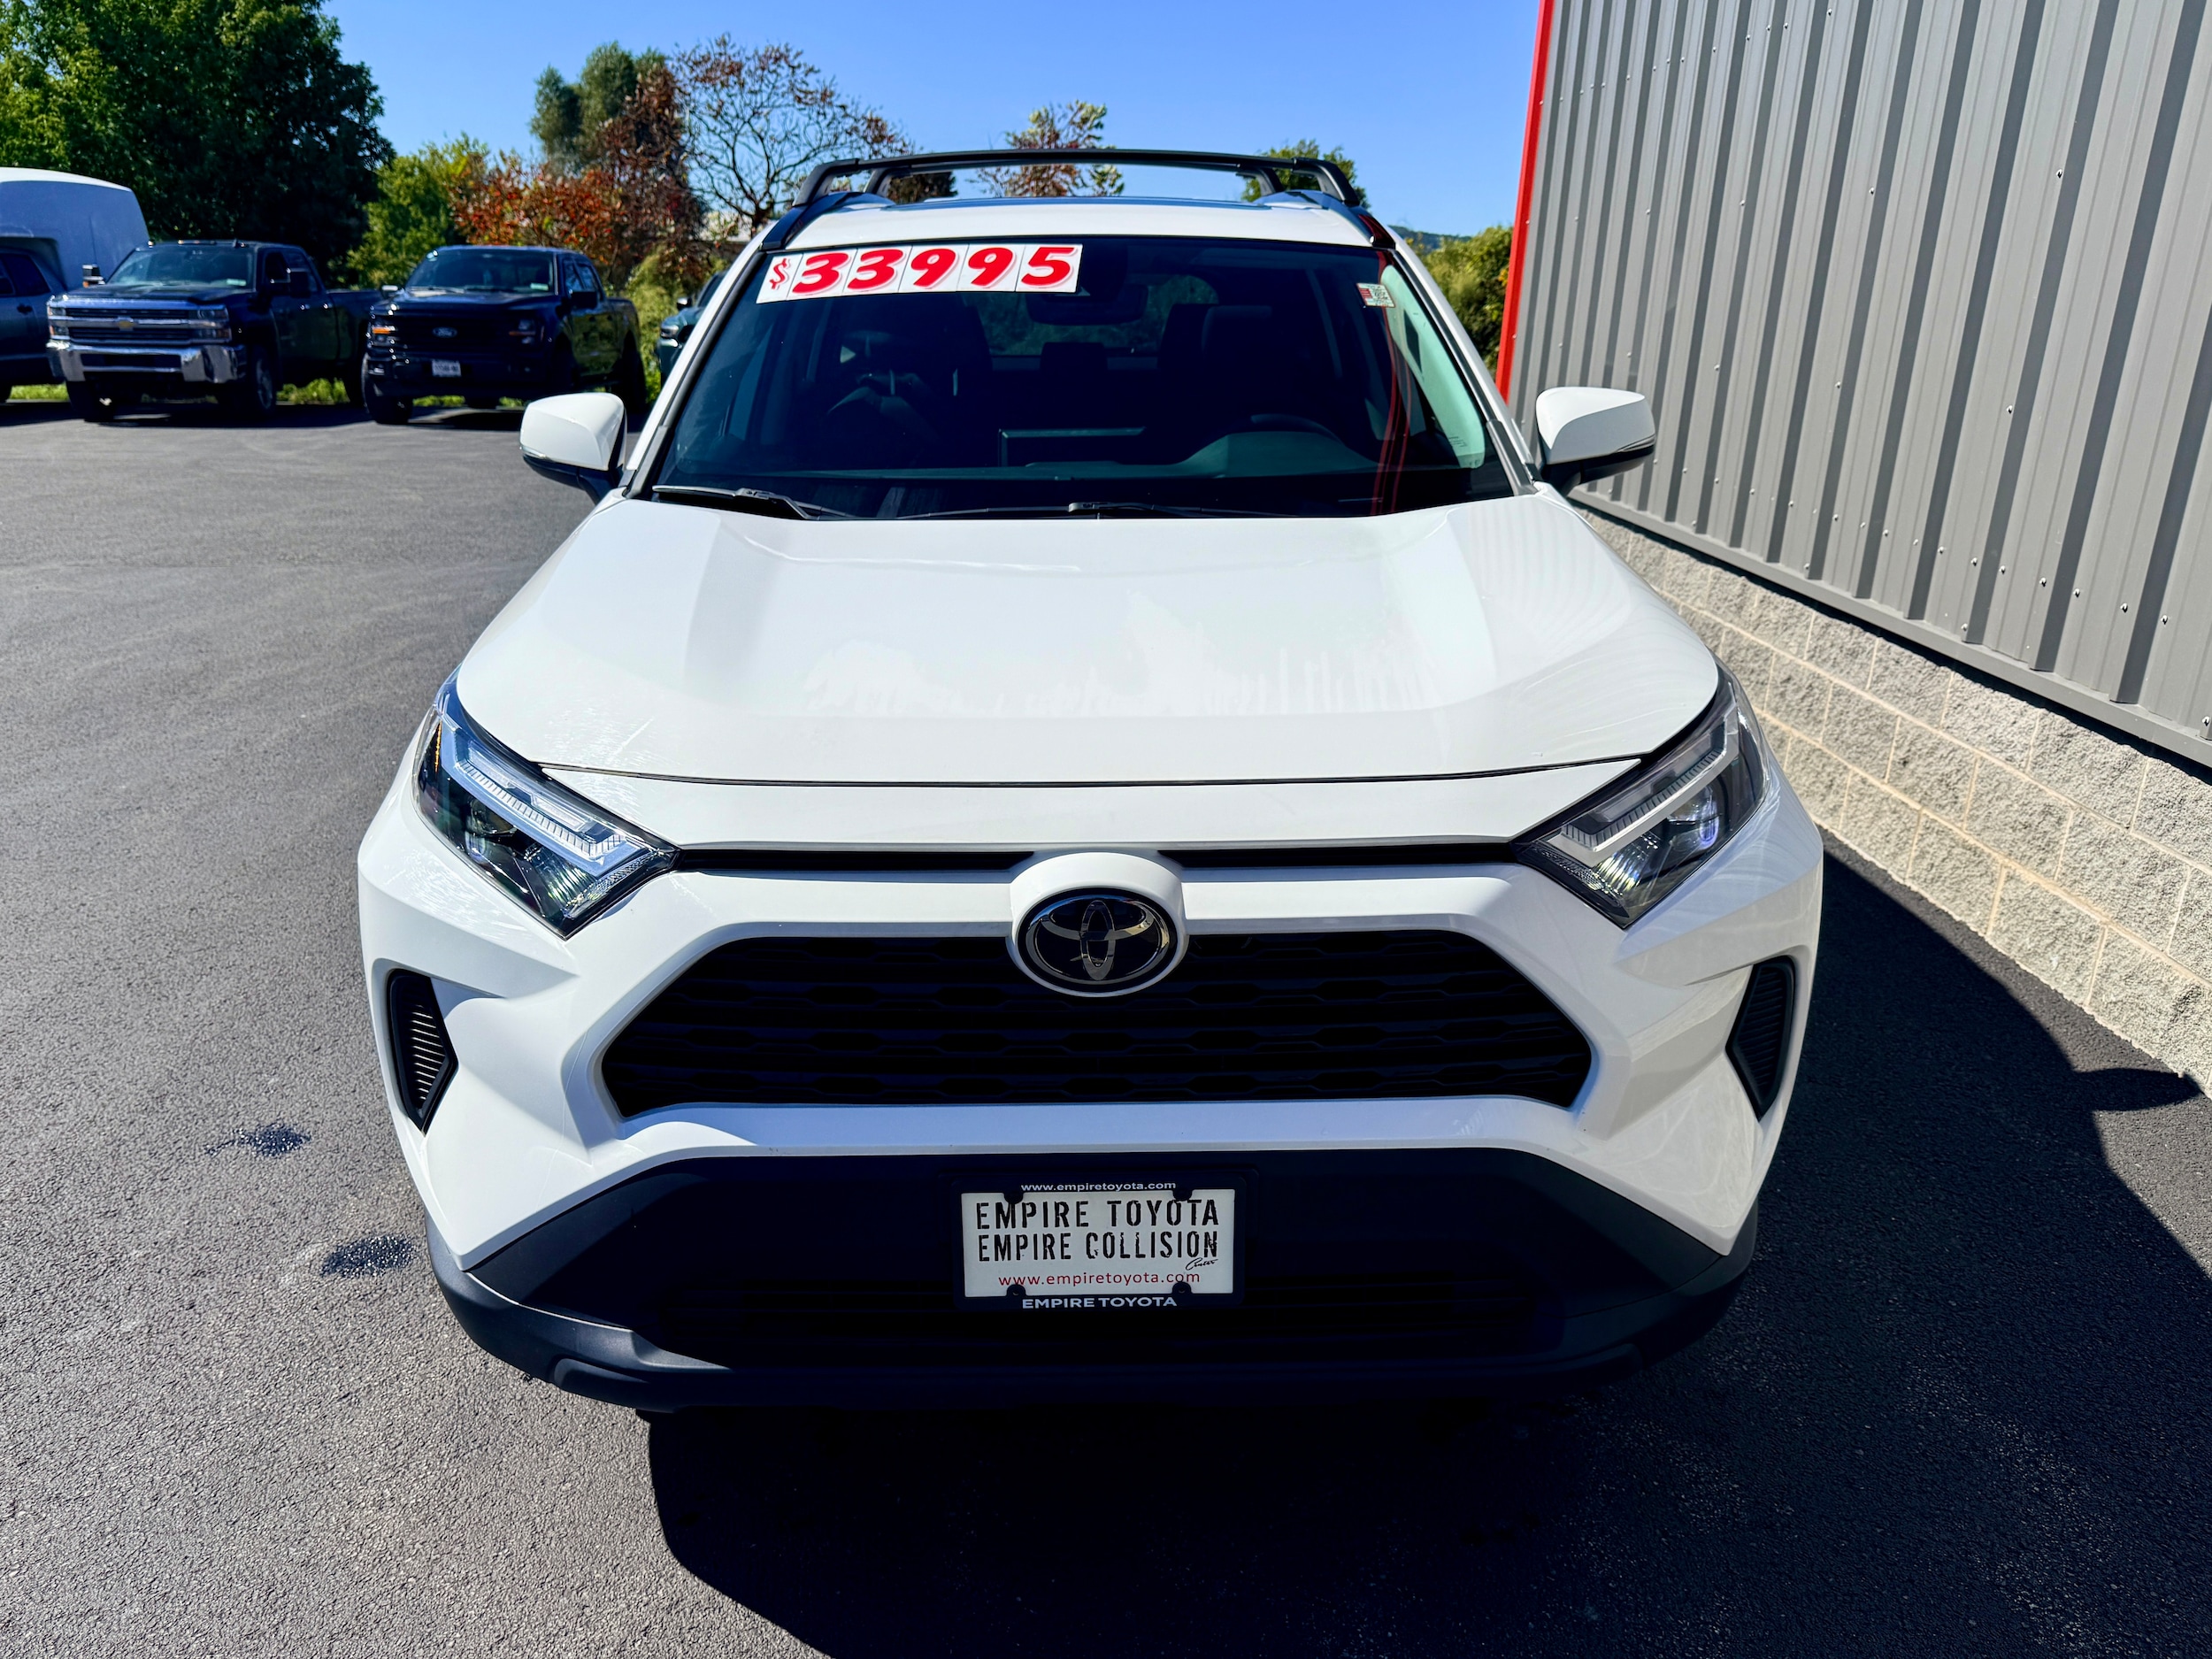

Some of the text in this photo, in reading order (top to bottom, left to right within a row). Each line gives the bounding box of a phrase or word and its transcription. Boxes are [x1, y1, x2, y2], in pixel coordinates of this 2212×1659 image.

[1020, 1181, 1177, 1192] www.empiretoyota.com
[976, 1199, 1219, 1229] EMPIRE TOYOTA
[979, 1231, 1217, 1262] EMPIRE COLLISION
[998, 1271, 1201, 1287] www.empiretoyota.com
[1022, 1297, 1178, 1310] EMPIRE TOYOTA
